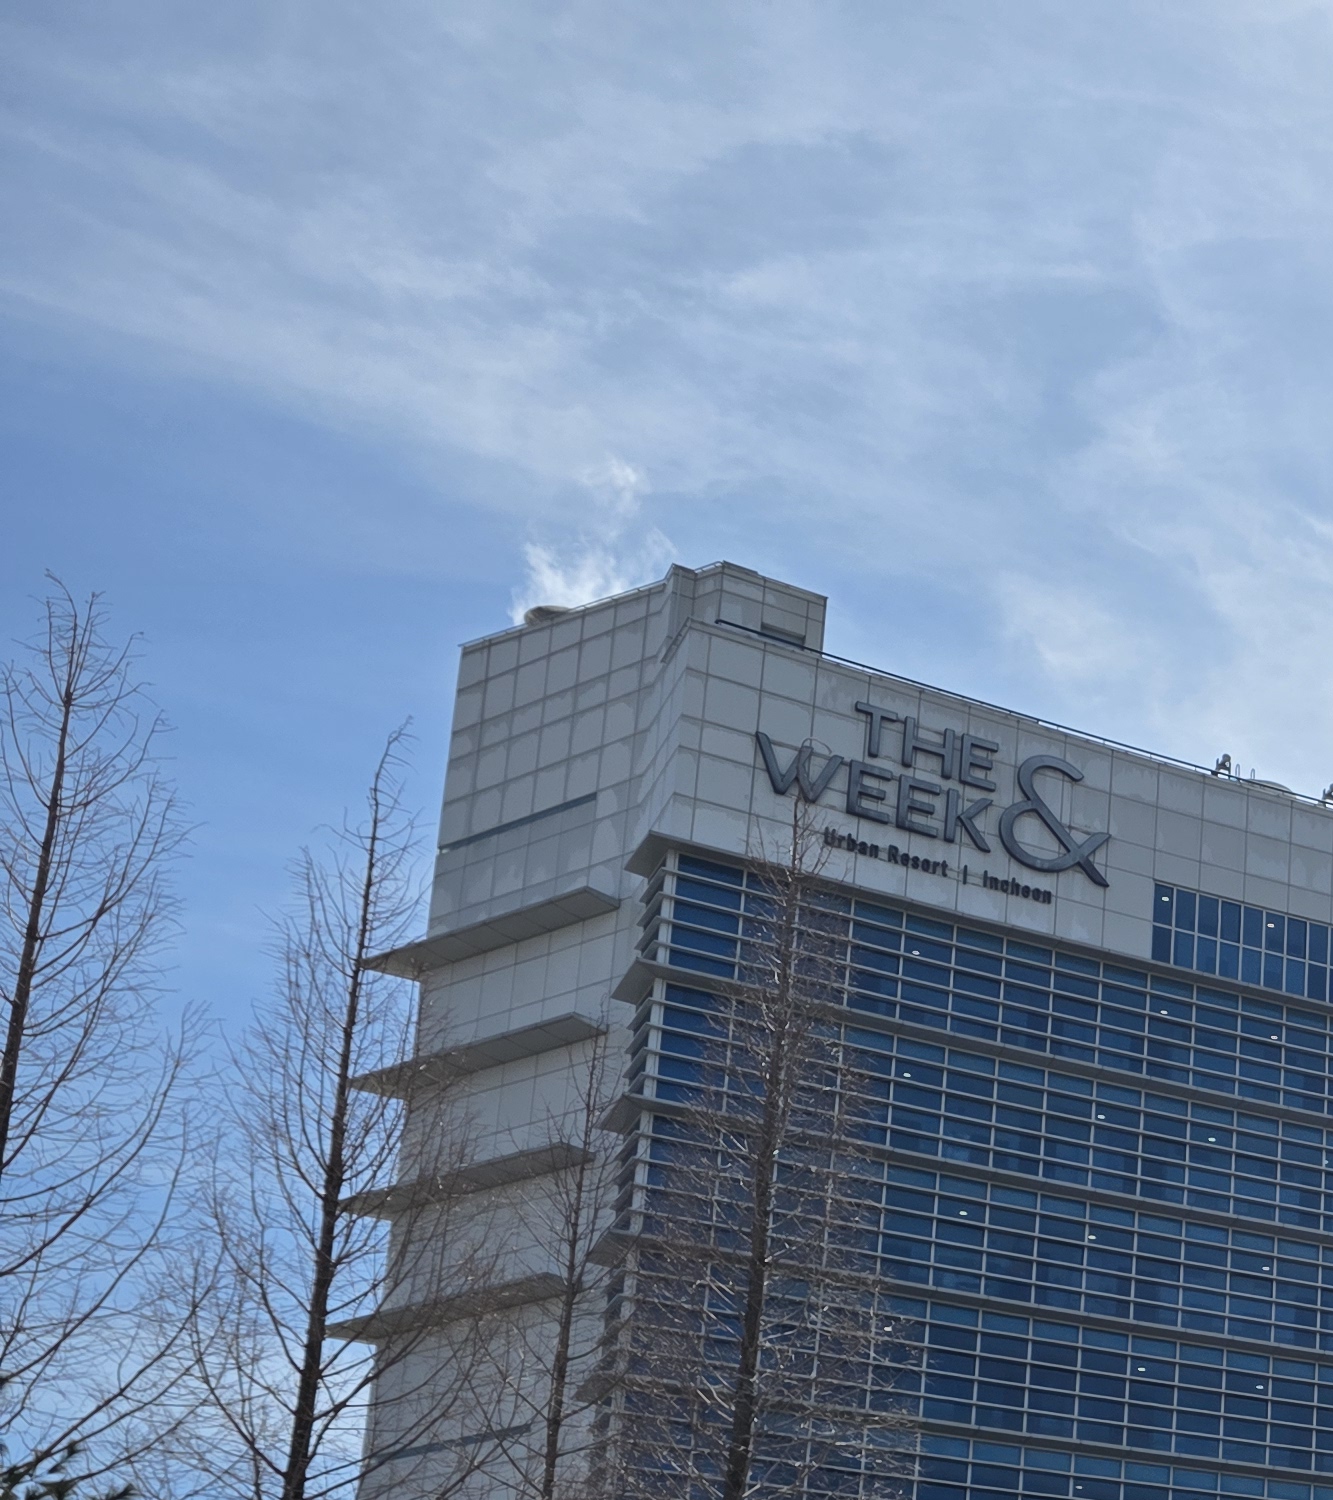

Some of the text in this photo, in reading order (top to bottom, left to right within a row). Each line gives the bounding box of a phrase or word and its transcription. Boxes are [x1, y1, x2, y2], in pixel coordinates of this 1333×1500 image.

[855, 700, 999, 792] THE
[823, 826, 879, 859] Urban
[888, 844, 948, 878] Resort
[983, 870, 1052, 905] Incheon
